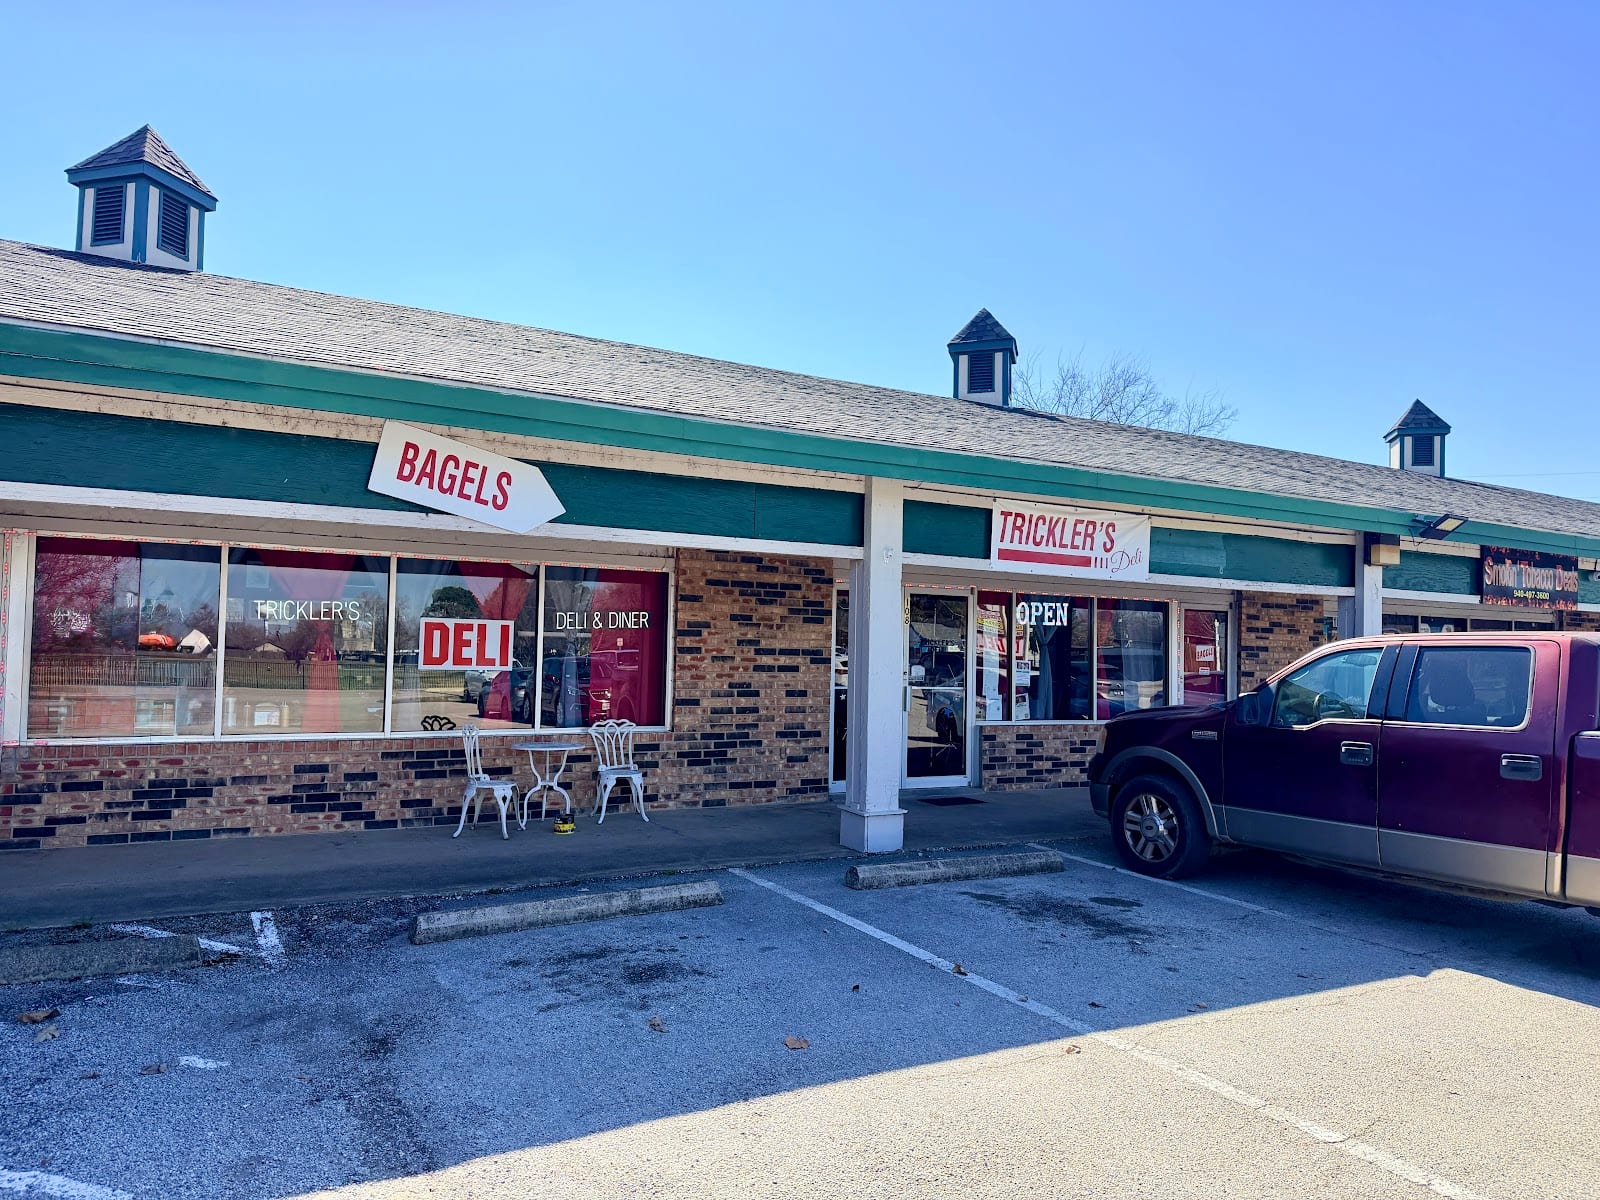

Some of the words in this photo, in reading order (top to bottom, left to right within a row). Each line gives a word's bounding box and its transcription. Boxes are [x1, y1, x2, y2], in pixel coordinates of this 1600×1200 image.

[396, 441, 512, 511] BAGELS
[999, 511, 1116, 553] TRICKLER'S
[1111, 548, 1142, 573] Deli
[1520, 561, 1553, 589] Tobacco
[1556, 565, 1578, 592] Deals
[253, 600, 361, 621] TRICKLER'S
[556, 612, 588, 629] DELI
[592, 612, 603, 629] &
[608, 612, 650, 629] DINER
[1015, 601, 1069, 626] OPEN
[422, 621, 510, 667] DELI
